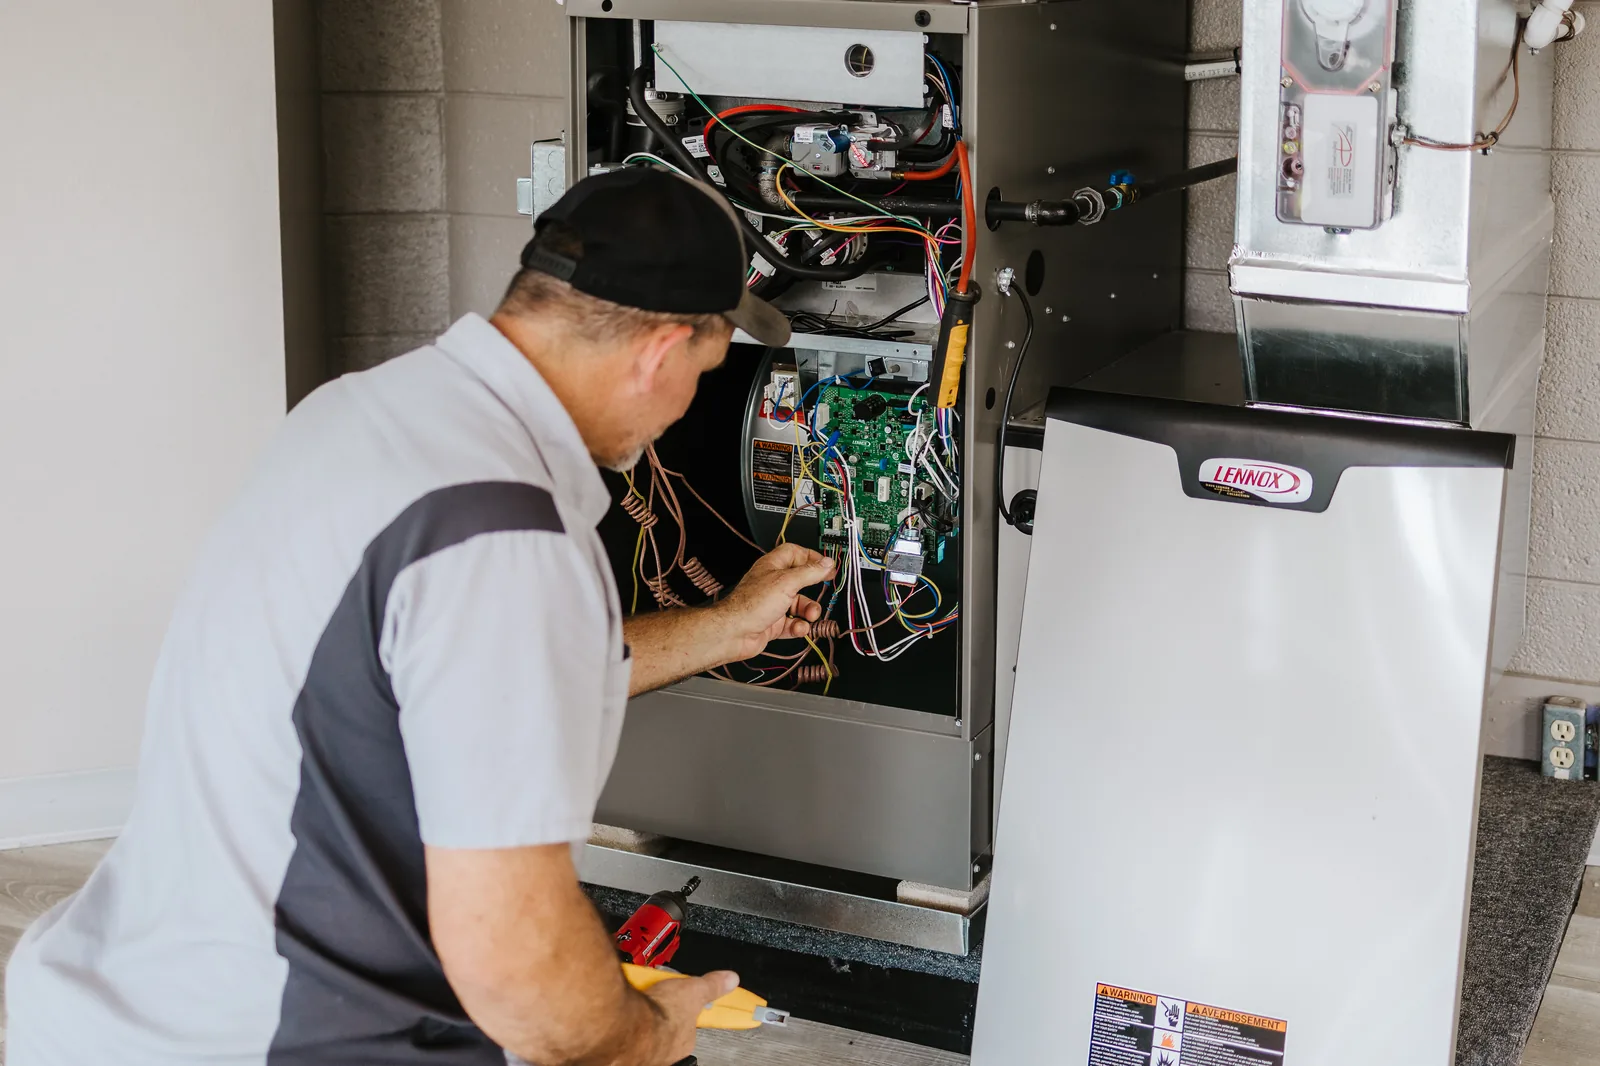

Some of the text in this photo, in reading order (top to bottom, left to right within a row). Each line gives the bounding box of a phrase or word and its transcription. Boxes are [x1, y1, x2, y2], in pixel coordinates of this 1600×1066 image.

[762, 441, 791, 452] WARNING
[1214, 466, 1283, 488] LENNOX
[1110, 988, 1153, 1004] WARNING
[1202, 1007, 1281, 1030] AVERTISSEMENT
